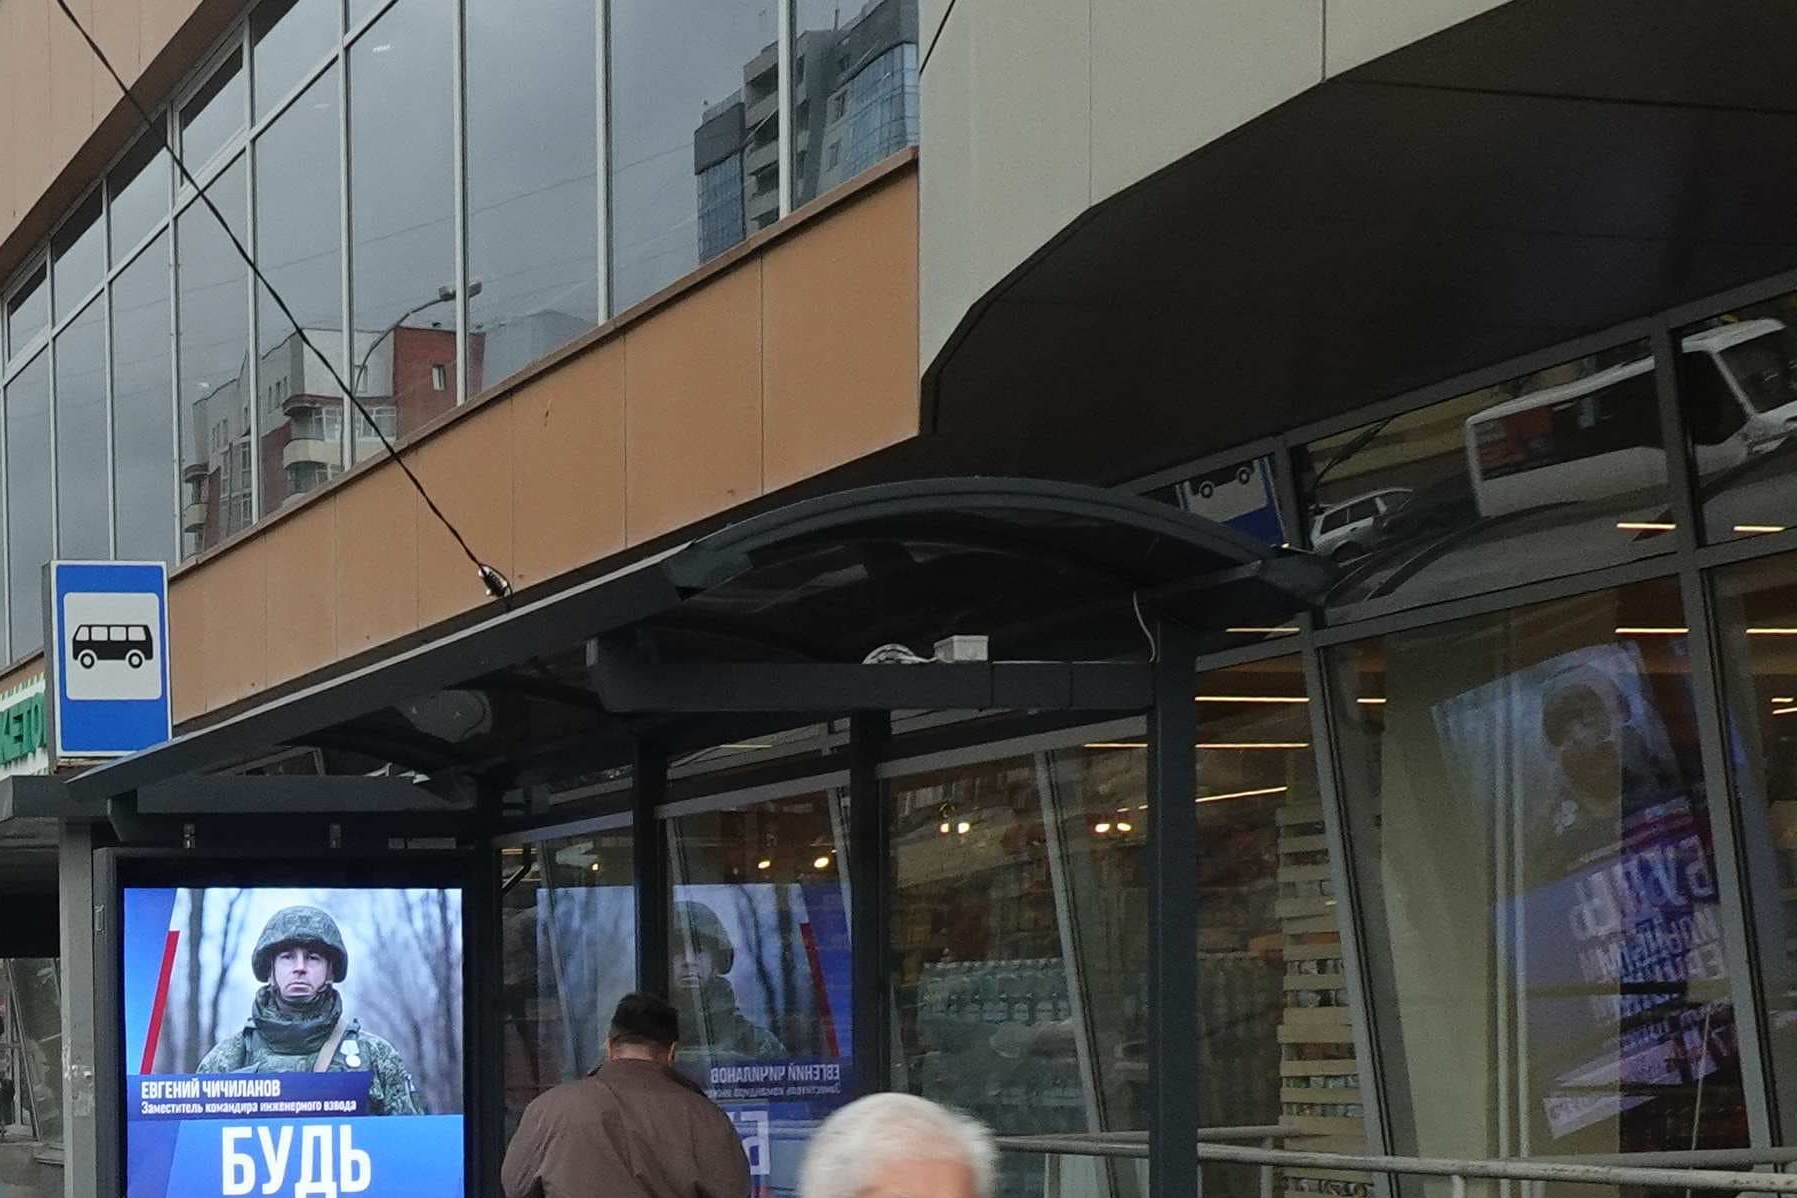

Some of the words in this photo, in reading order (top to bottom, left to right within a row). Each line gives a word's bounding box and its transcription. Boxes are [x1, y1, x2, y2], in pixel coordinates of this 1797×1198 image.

[141, 1078, 200, 1099] ЕВГЕНИЙ
[203, 1079, 281, 1098] ЧИЧИЛАНОВ
[141, 1101, 203, 1115] Заместитель
[205, 1101, 259, 1115] командира
[260, 1100, 322, 1114] инженерного
[324, 1099, 357, 1112] взвода
